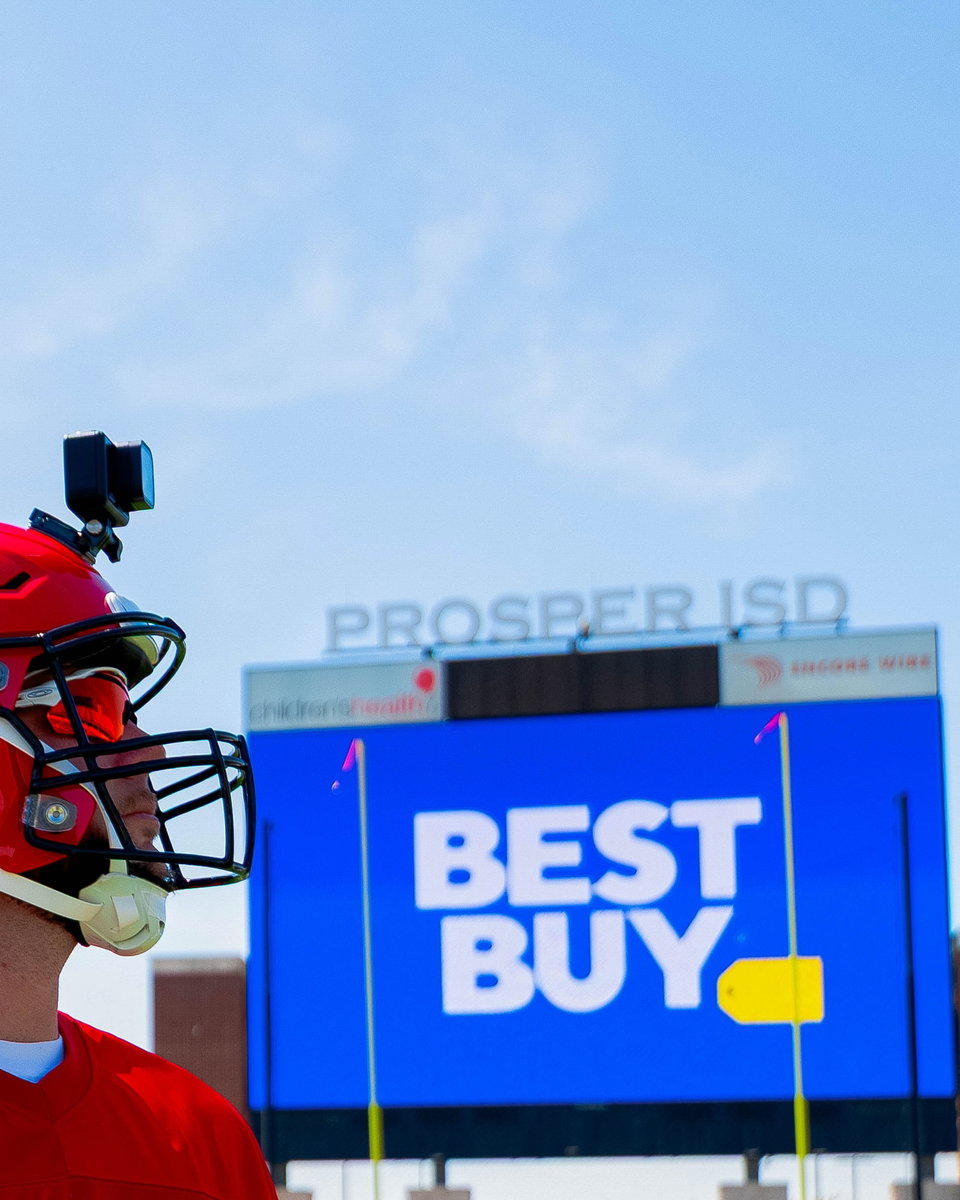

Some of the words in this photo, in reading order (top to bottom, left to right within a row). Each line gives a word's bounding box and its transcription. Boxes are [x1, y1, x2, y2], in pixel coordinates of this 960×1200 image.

[324, 585, 695, 652] PROSPER
[718, 573, 850, 631] ISD
[414, 797, 762, 910] BEST
[441, 905, 734, 1015] BUY
